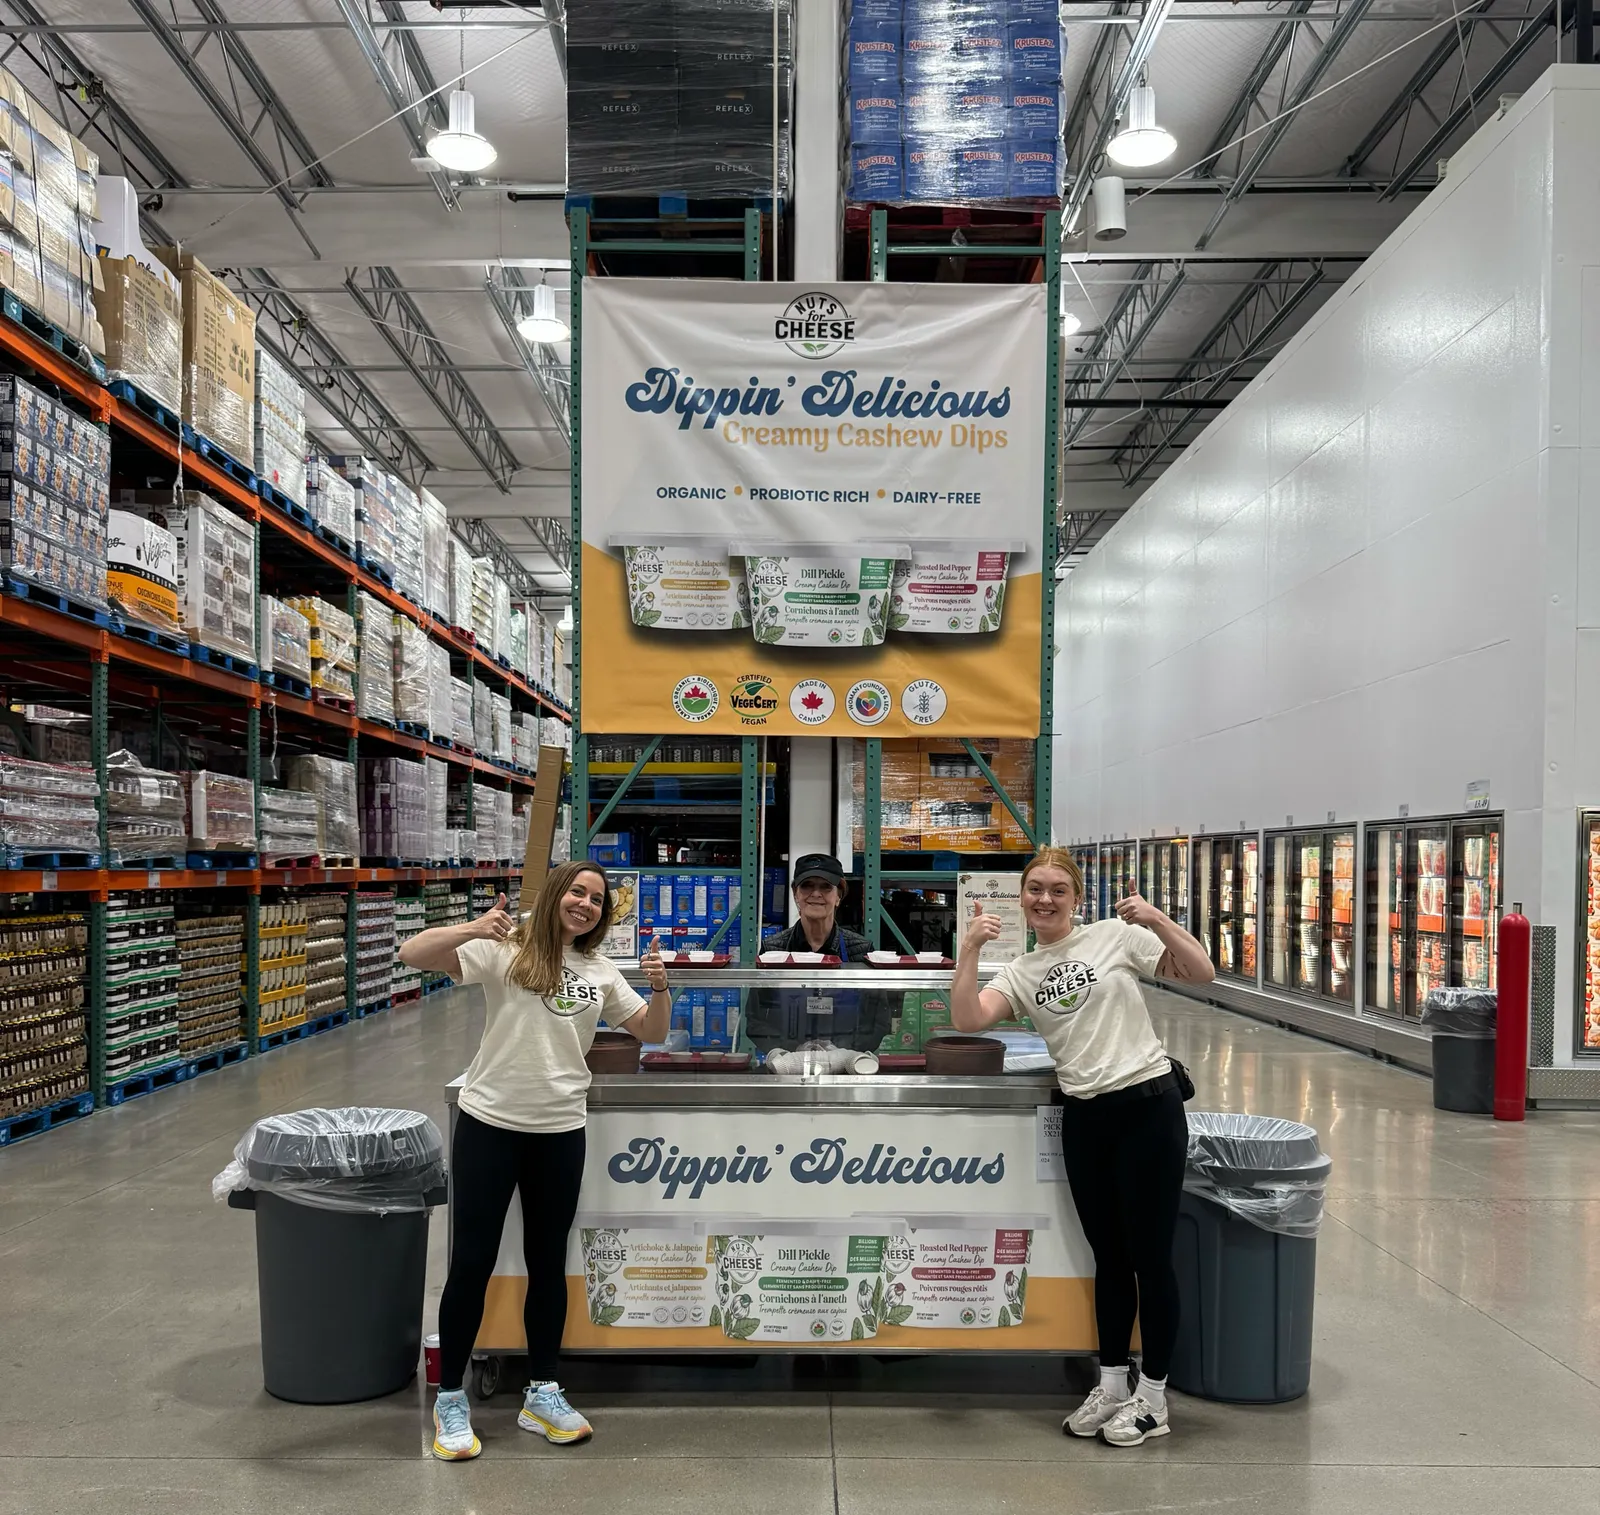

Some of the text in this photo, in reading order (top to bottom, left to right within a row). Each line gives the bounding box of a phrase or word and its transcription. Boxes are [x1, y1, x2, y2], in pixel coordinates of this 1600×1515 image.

[855, 42, 896, 53] KRUSTEAZ
[1014, 38, 1055, 49] KRUSTEAZ
[717, 53, 754, 62] REFLEX
[856, 98, 896, 110] KRUSTEAZ
[1014, 96, 1054, 107] KRUSTEAZ
[603, 104, 640, 114] REFLEX
[716, 105, 753, 115] REFLEX
[857, 155, 896, 170] KRUSTEAZ
[963, 152, 1004, 162] KRUSTEAZ
[1014, 152, 1054, 163] KRUSTEAZ
[715, 165, 753, 174] REFLEX
[794, 297, 837, 315] NUTS
[806, 310, 825, 322] for
[775, 320, 855, 340] CHEESE
[801, 370, 1010, 418] Delicious
[723, 420, 1008, 454] Creamy Cashew Dips
[656, 487, 981, 504] ORGANIC PROBIOTIC RICH DAIRY-FREE
[633, 563, 663, 574] CHEESE
[712, 568, 721, 578] Dip
[801, 569, 845, 579] Dill Pickle
[951, 564, 971, 574] Pepper
[754, 574, 788, 586] CHEESE
[916, 572, 969, 583] Creamy Cashew Dip
[794, 580, 851, 591] Creamy Cashew Dip
[784, 605, 828, 615] Cornichons
[828, 606, 834, 615] à
[736, 674, 772, 684] CERTIFIED
[798, 681, 827, 690] MADE IN
[908, 681, 941, 693] GLUTEN
[848, 687, 860, 711] WOMAN
[859, 682, 886, 696] FOUNDED
[741, 717, 767, 725] VEGAN
[798, 713, 827, 723] CANADA
[913, 715, 934, 723] FREE
[1047, 964, 1079, 983] NUTS
[1035, 967, 1097, 1006] CHEESE
[790, 1137, 1005, 1184] Delicious
[630, 1244, 664, 1252] Artichoke
[730, 1243, 750, 1253] NUTS
[920, 1244, 988, 1255] Roasted Red Pepper
[590, 1249, 627, 1260] CHEESE
[635, 1253, 697, 1265] Creamy Cashew Dip
[778, 1249, 830, 1260] Dill Pickle
[723, 1257, 762, 1270] CHEESE
[922, 1254, 985, 1267] Creamy Cashew Dip
[770, 1262, 837, 1275] Creamy Cashew Dip
[920, 1284, 948, 1292] Poivrons
[949, 1285, 971, 1294] rouges
[759, 1293, 809, 1304] Cornichons
[811, 1293, 817, 1304] à
[912, 1292, 937, 1304] Trempette
[759, 1304, 786, 1317] Trempette
